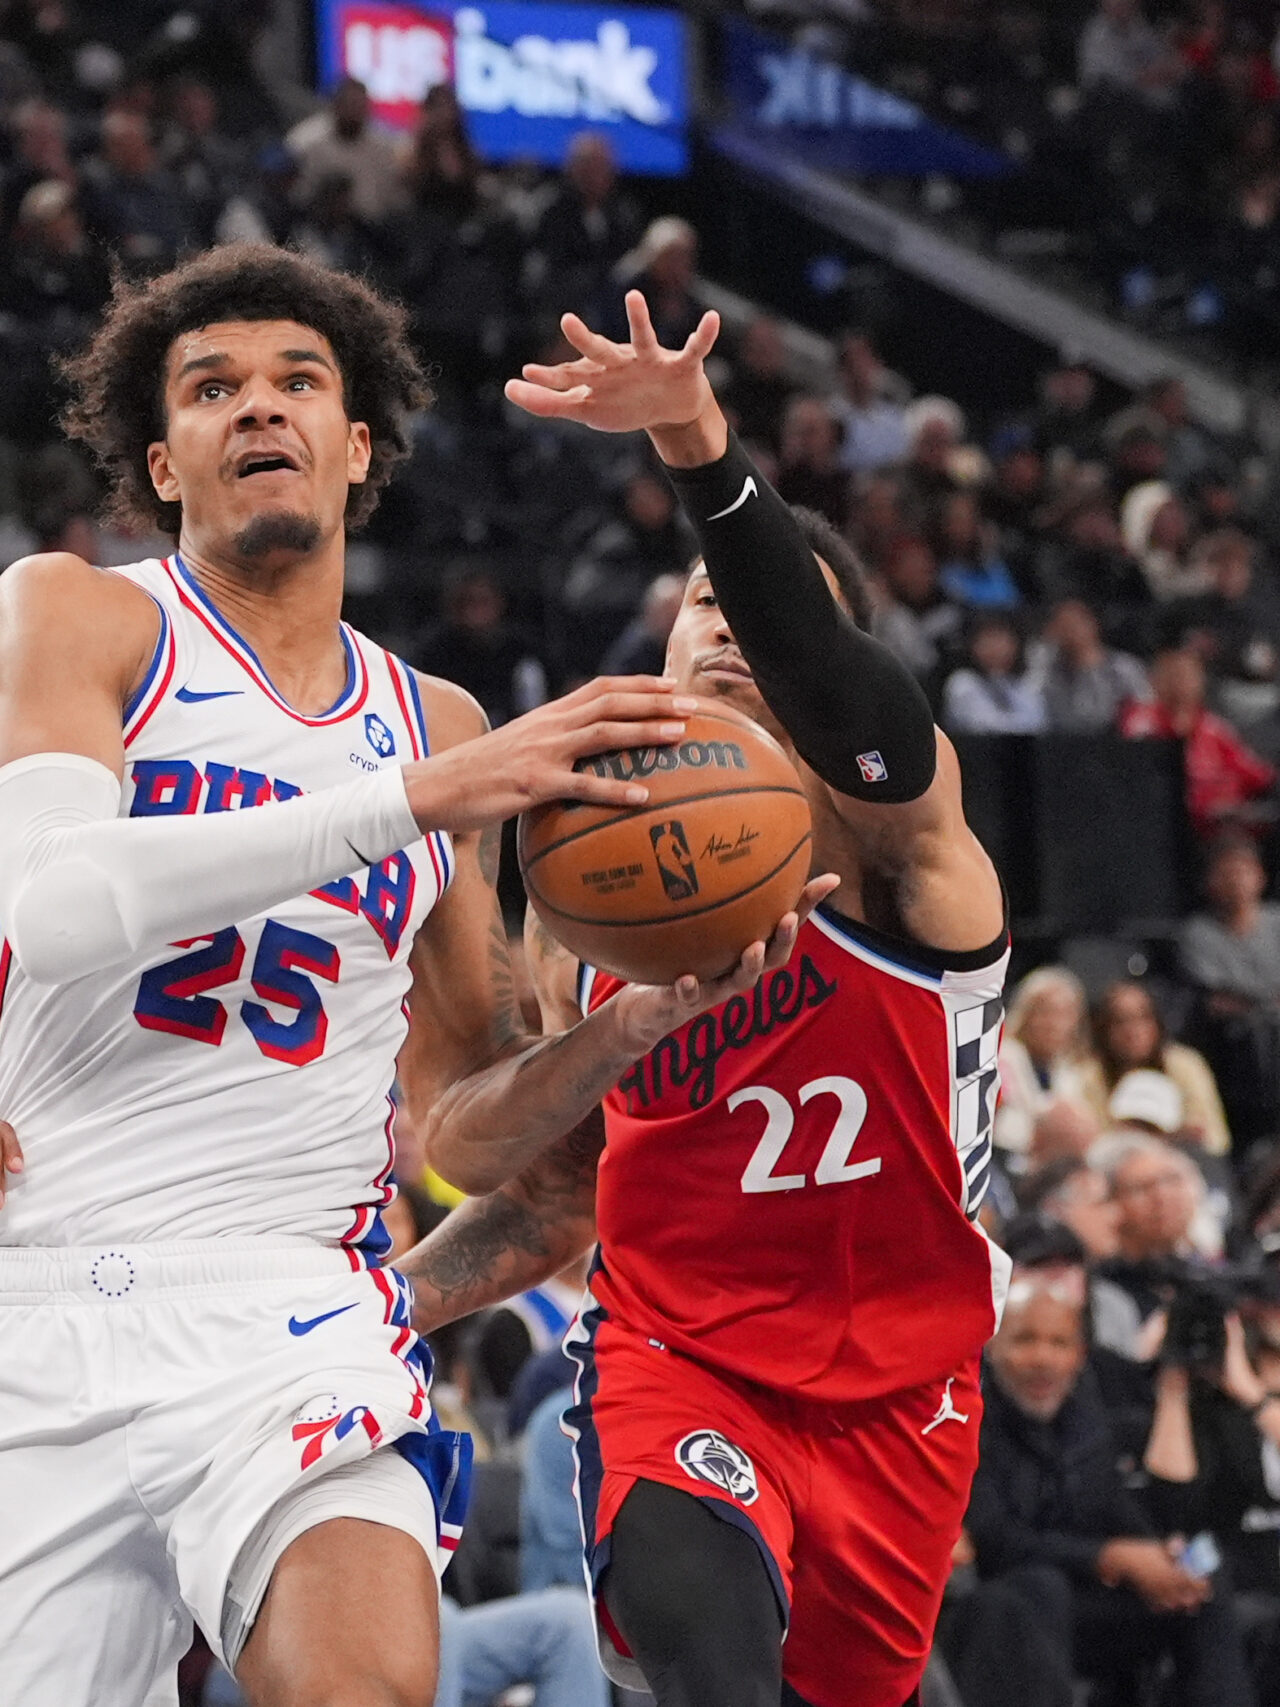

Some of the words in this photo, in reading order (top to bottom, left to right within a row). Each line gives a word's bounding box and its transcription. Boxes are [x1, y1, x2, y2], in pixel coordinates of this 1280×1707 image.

[454, 8, 666, 124] bank
[133, 918, 341, 1067] 25
[726, 1075, 882, 1194] 22
